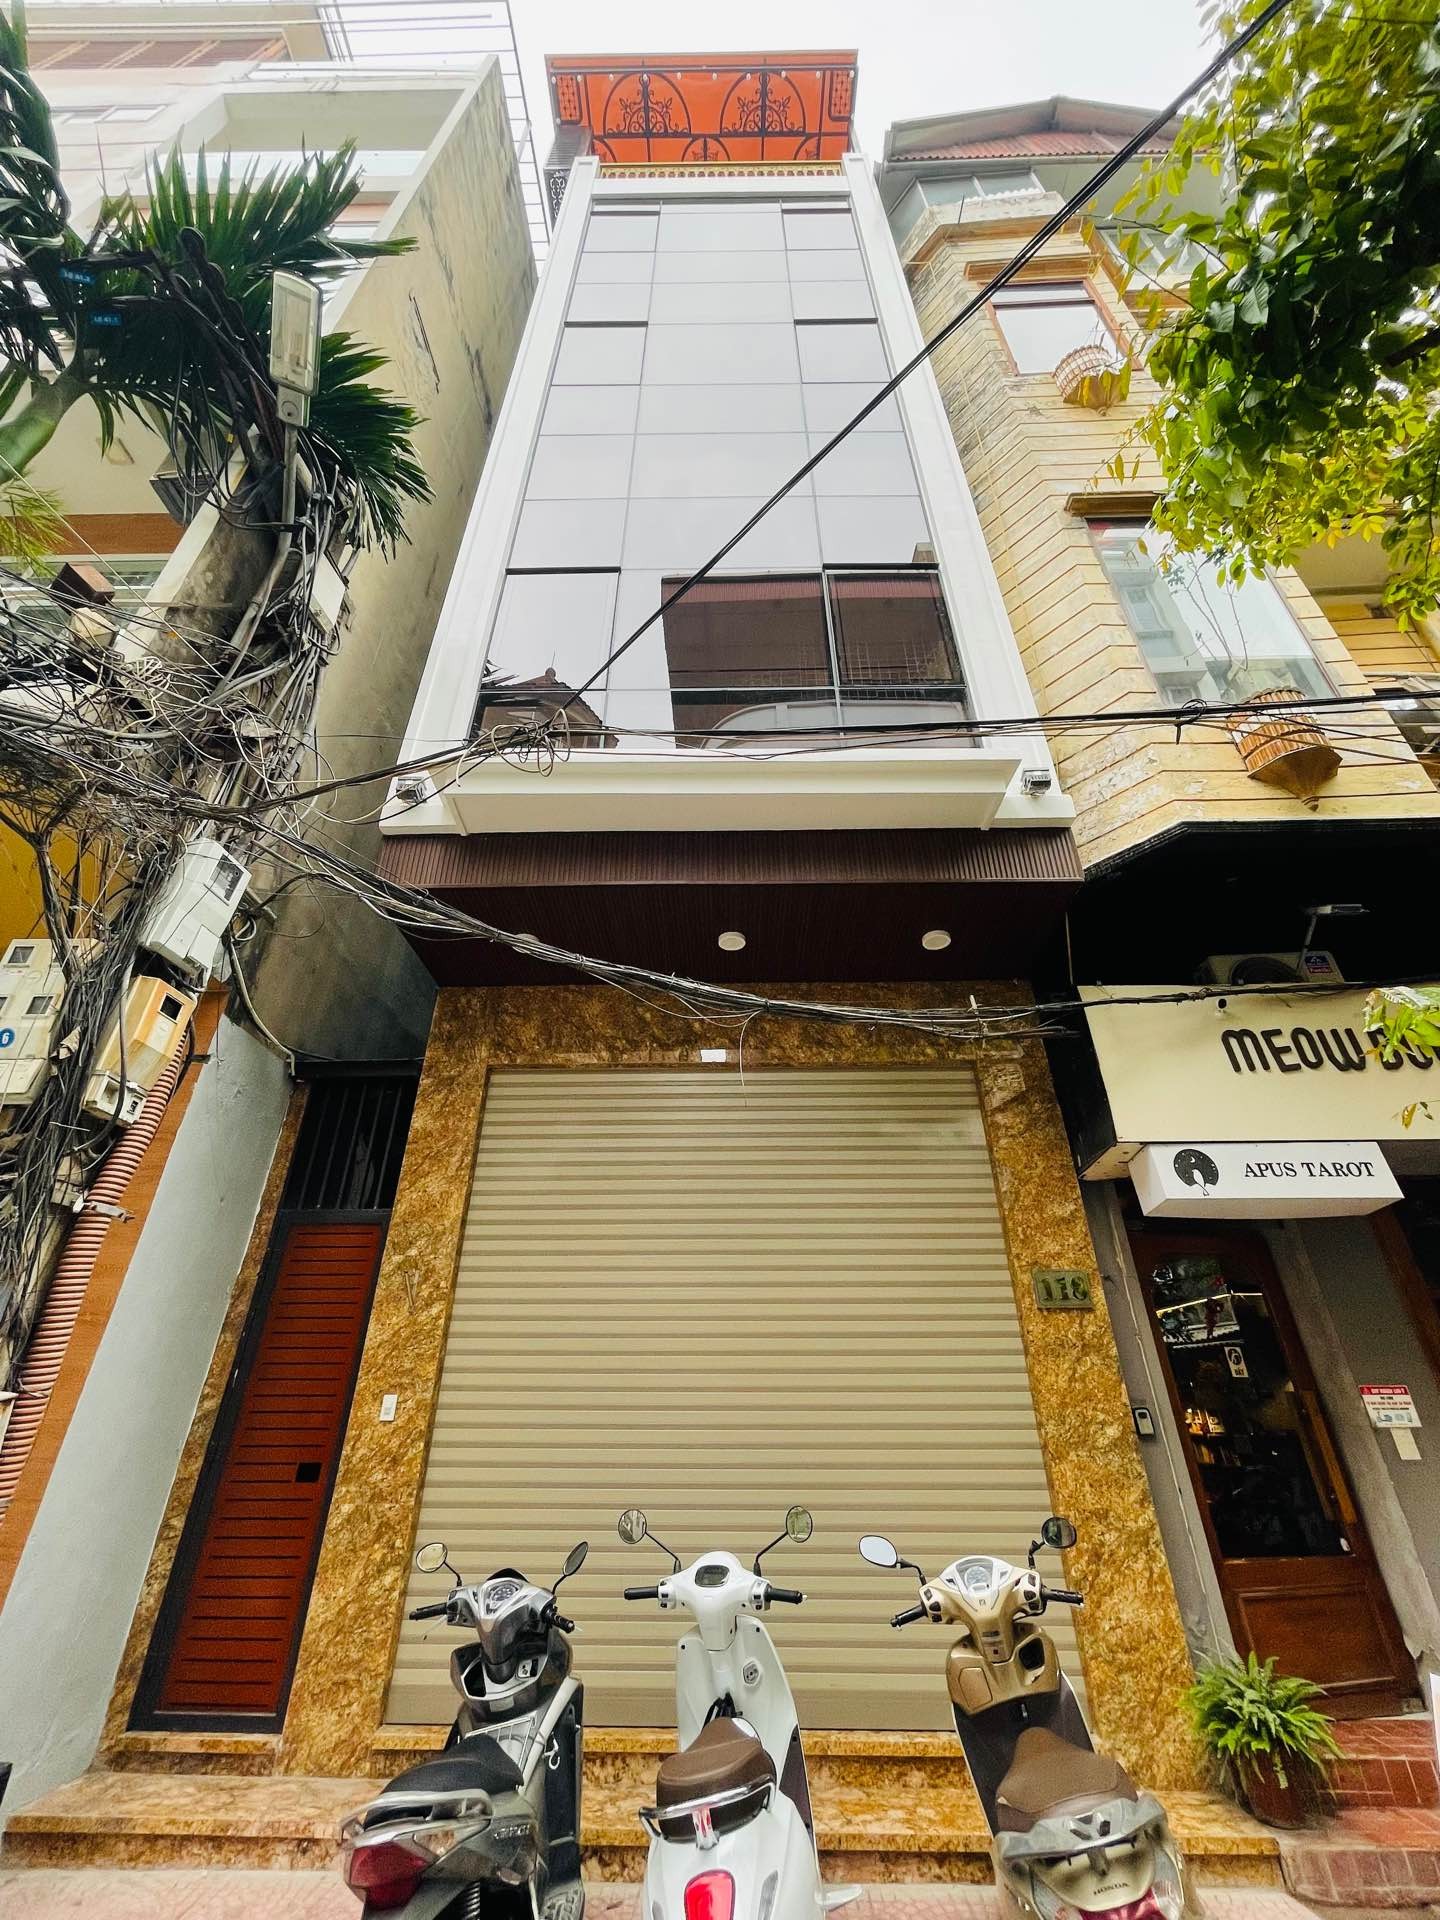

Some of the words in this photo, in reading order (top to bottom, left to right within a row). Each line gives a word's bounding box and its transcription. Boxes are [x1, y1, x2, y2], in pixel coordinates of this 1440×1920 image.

[1221, 1027, 1366, 1072] MEOW
[1244, 1162, 1298, 1178] APUS
[1300, 1162, 1376, 1178] TAROT
[1093, 1882, 1130, 1896] HONDA
